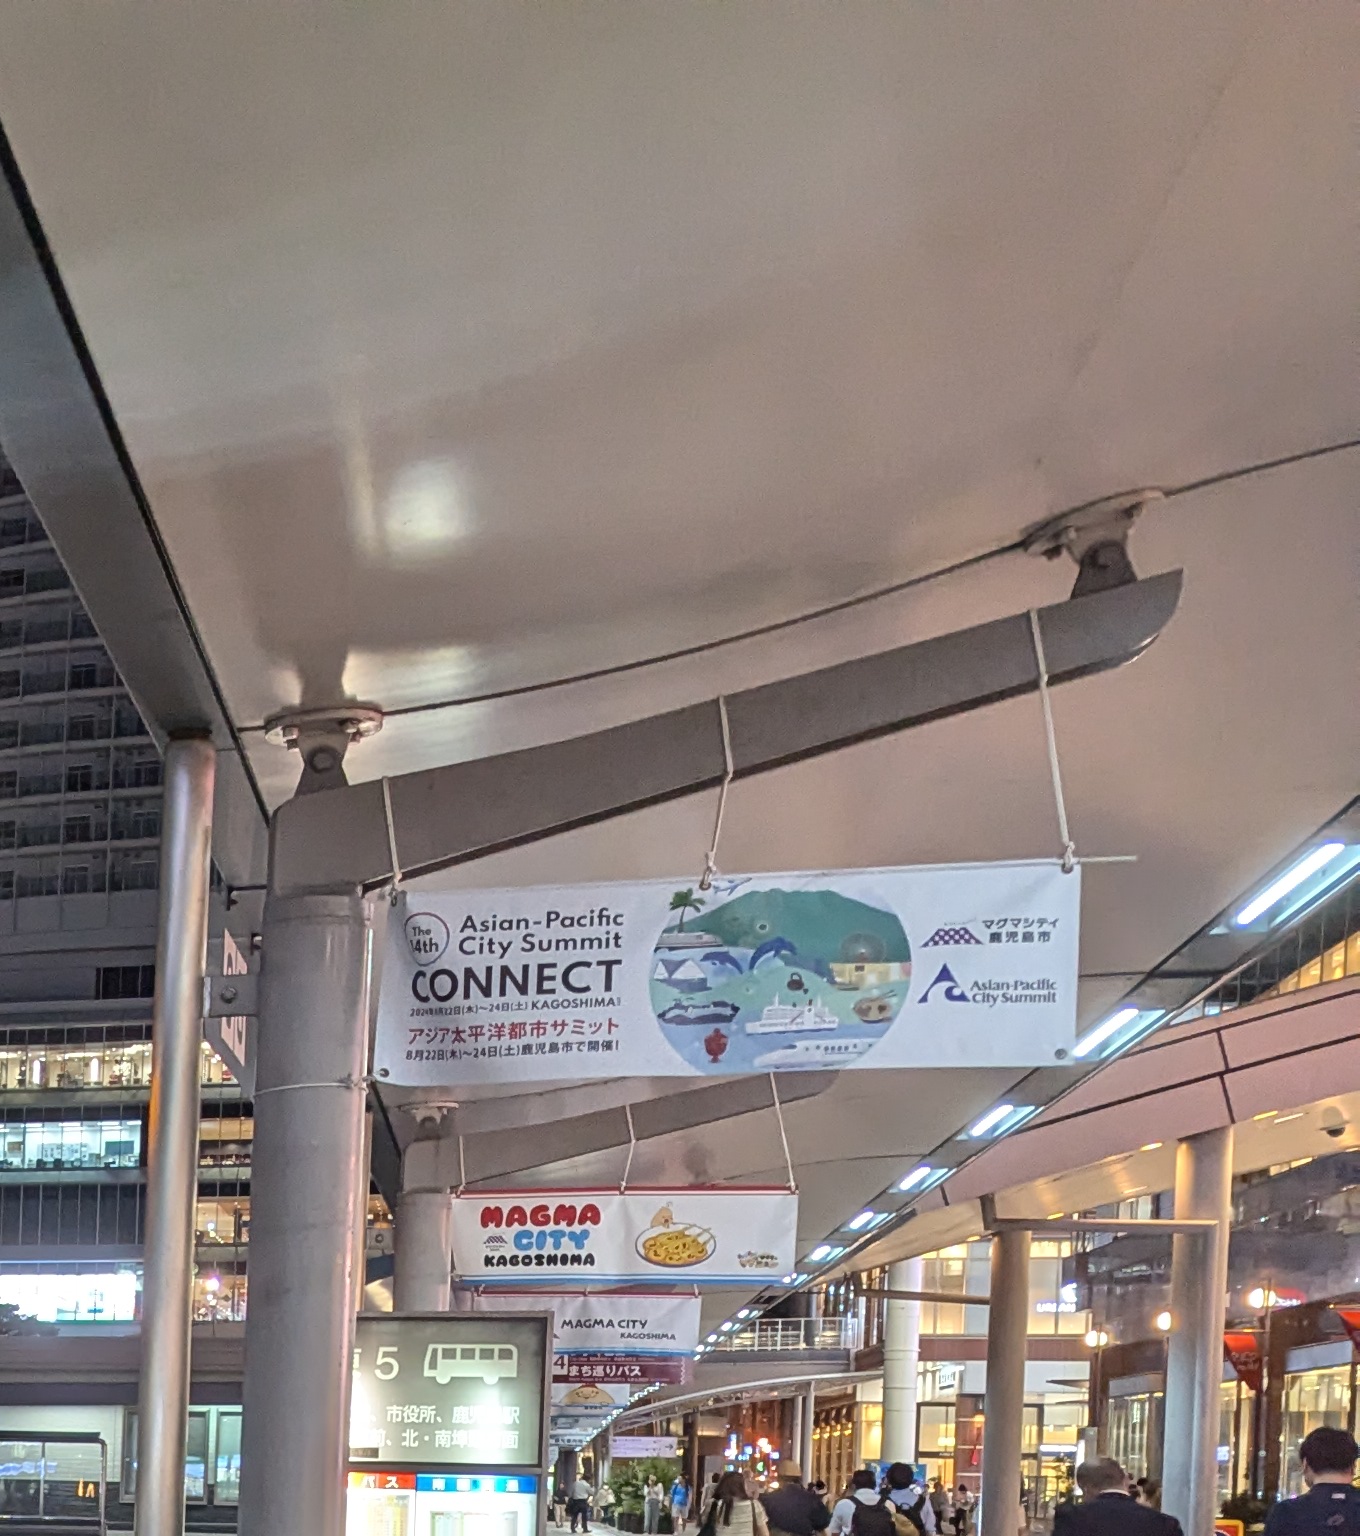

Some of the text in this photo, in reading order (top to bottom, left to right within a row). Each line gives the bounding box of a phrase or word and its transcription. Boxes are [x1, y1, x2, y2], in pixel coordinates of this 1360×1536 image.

[459, 907, 624, 933] Asian-Pacific
[982, 918, 1059, 929] マグマシティ
[412, 926, 432, 937] The
[989, 931, 1051, 943] 鹿児島市
[458, 931, 623, 959] City Summit
[411, 959, 623, 1003] CONNECT
[970, 979, 1057, 991] Asian-Pacific
[531, 997, 616, 1011] KAGOSHIMA
[972, 991, 1057, 1007] City Summit
[408, 1017, 620, 1045] アジア太平洋都市サミット
[480, 1202, 601, 1229] MAGMA
[513, 1229, 591, 1252] CITY
[484, 1253, 596, 1268] KAGOSHIMA
[561, 1318, 648, 1330] MAGMA CITY
[620, 1332, 676, 1341] KAGOSHIMA
[374, 1346, 400, 1380] 5
[553, 1354, 567, 1370] 4
[569, 1365, 642, 1377] まち巡りバス
